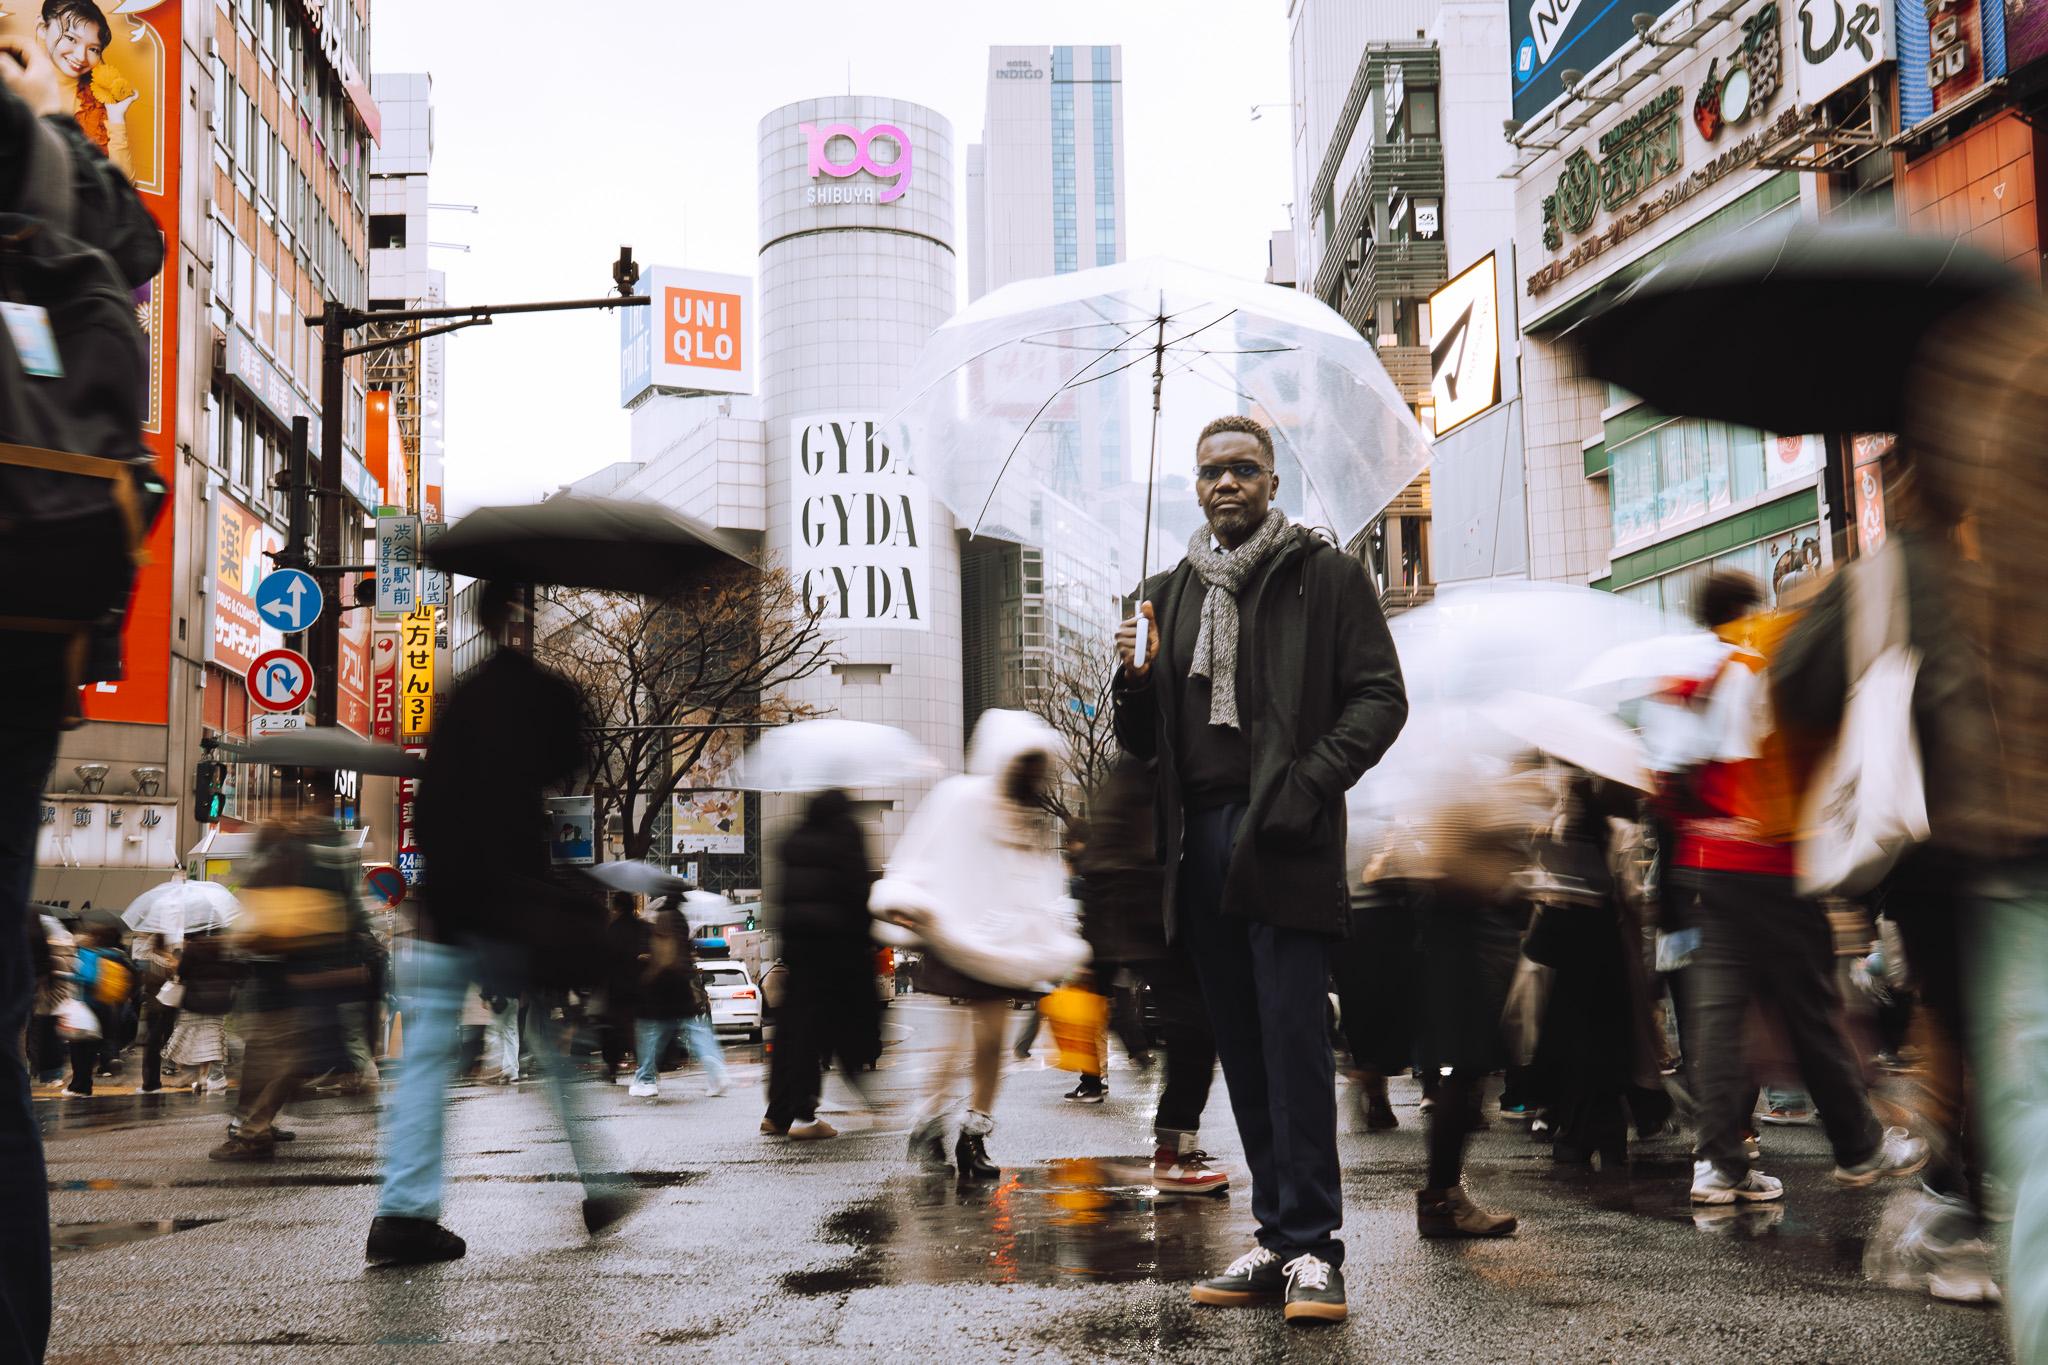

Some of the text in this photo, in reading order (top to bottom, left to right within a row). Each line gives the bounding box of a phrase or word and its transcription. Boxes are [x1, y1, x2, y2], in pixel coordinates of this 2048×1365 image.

[996, 69, 1043, 79] INDIGO
[800, 124, 912, 203] 109
[807, 187, 873, 204] SHIBUYA
[673, 297, 727, 329] UNI
[673, 329, 733, 362] QLO
[801, 493, 919, 549] GYDA
[221, 513, 240, 585] 薬
[381, 536, 393, 574] Shibuya
[393, 523, 412, 605] 渋谷駅前
[801, 564, 920, 621] GYDA
[342, 644, 364, 692] アコム
[377, 678, 393, 722] アコム
[410, 698, 425, 731] 3F
[260, 718, 267, 728] 8
[283, 718, 297, 728] 20
[378, 727, 391, 736] 3F
